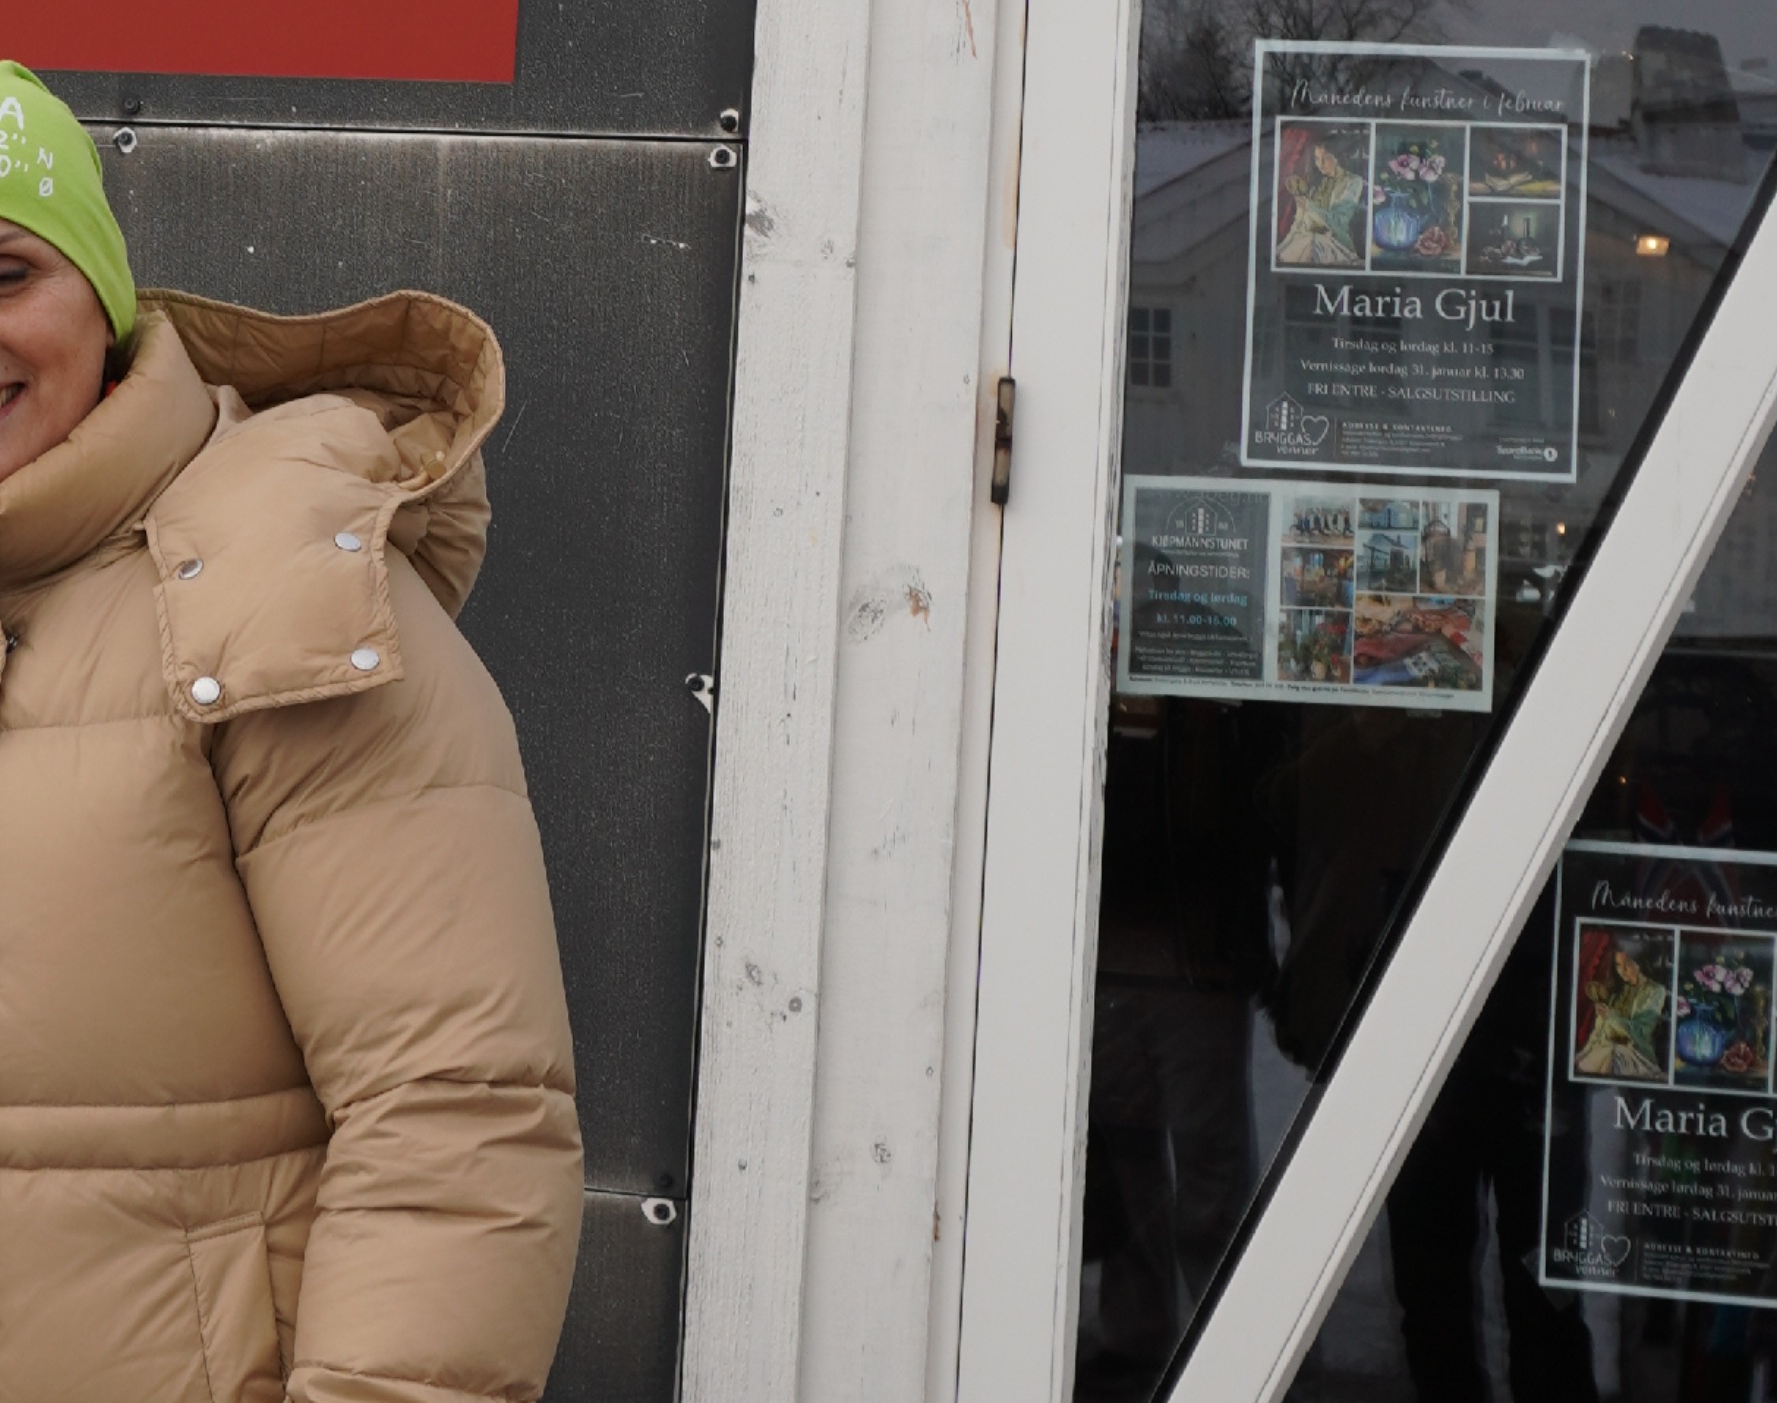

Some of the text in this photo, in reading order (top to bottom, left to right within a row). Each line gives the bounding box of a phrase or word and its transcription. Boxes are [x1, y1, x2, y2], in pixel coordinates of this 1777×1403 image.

[1313, 283, 1516, 332] Maria Gjul
[1332, 337, 1378, 354] Tirsdag
[1381, 340, 1397, 354] og
[1300, 358, 1366, 376] Vernissage
[1431, 364, 1471, 380] januar
[1388, 385, 1516, 404] SALGSUTSTILLING
[1255, 430, 1312, 446] BRYGGAS
[1149, 589, 1191, 603] Tirsdag
[1194, 592, 1209, 605] og
[1614, 1095, 1728, 1138] Maria
[1633, 1152, 1681, 1172] Tirsdag
[1684, 1158, 1701, 1174] og
[1601, 1174, 1670, 1195] Vernissage
[1553, 1246, 1612, 1266] BRYGGAS
